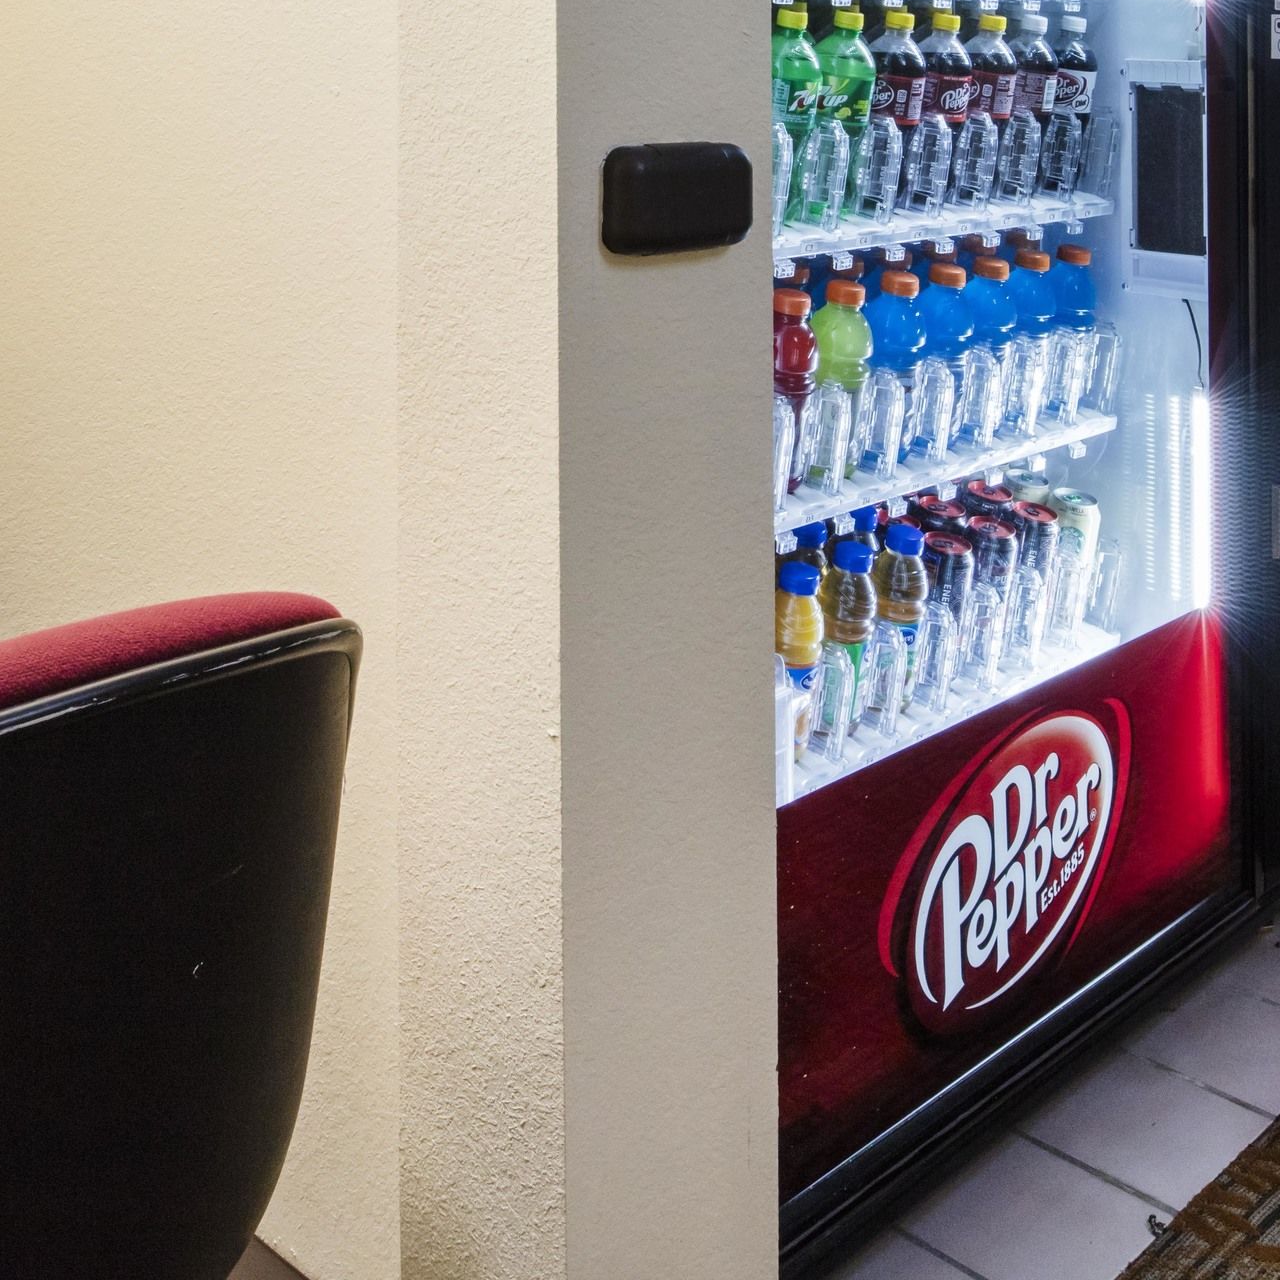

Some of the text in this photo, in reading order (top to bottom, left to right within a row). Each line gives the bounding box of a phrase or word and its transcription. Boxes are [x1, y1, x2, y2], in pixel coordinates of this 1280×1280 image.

[990, 752, 1060, 882] Dr
[1040, 841, 1087, 914] Est.1885
[915, 762, 1101, 1013] Pepper
